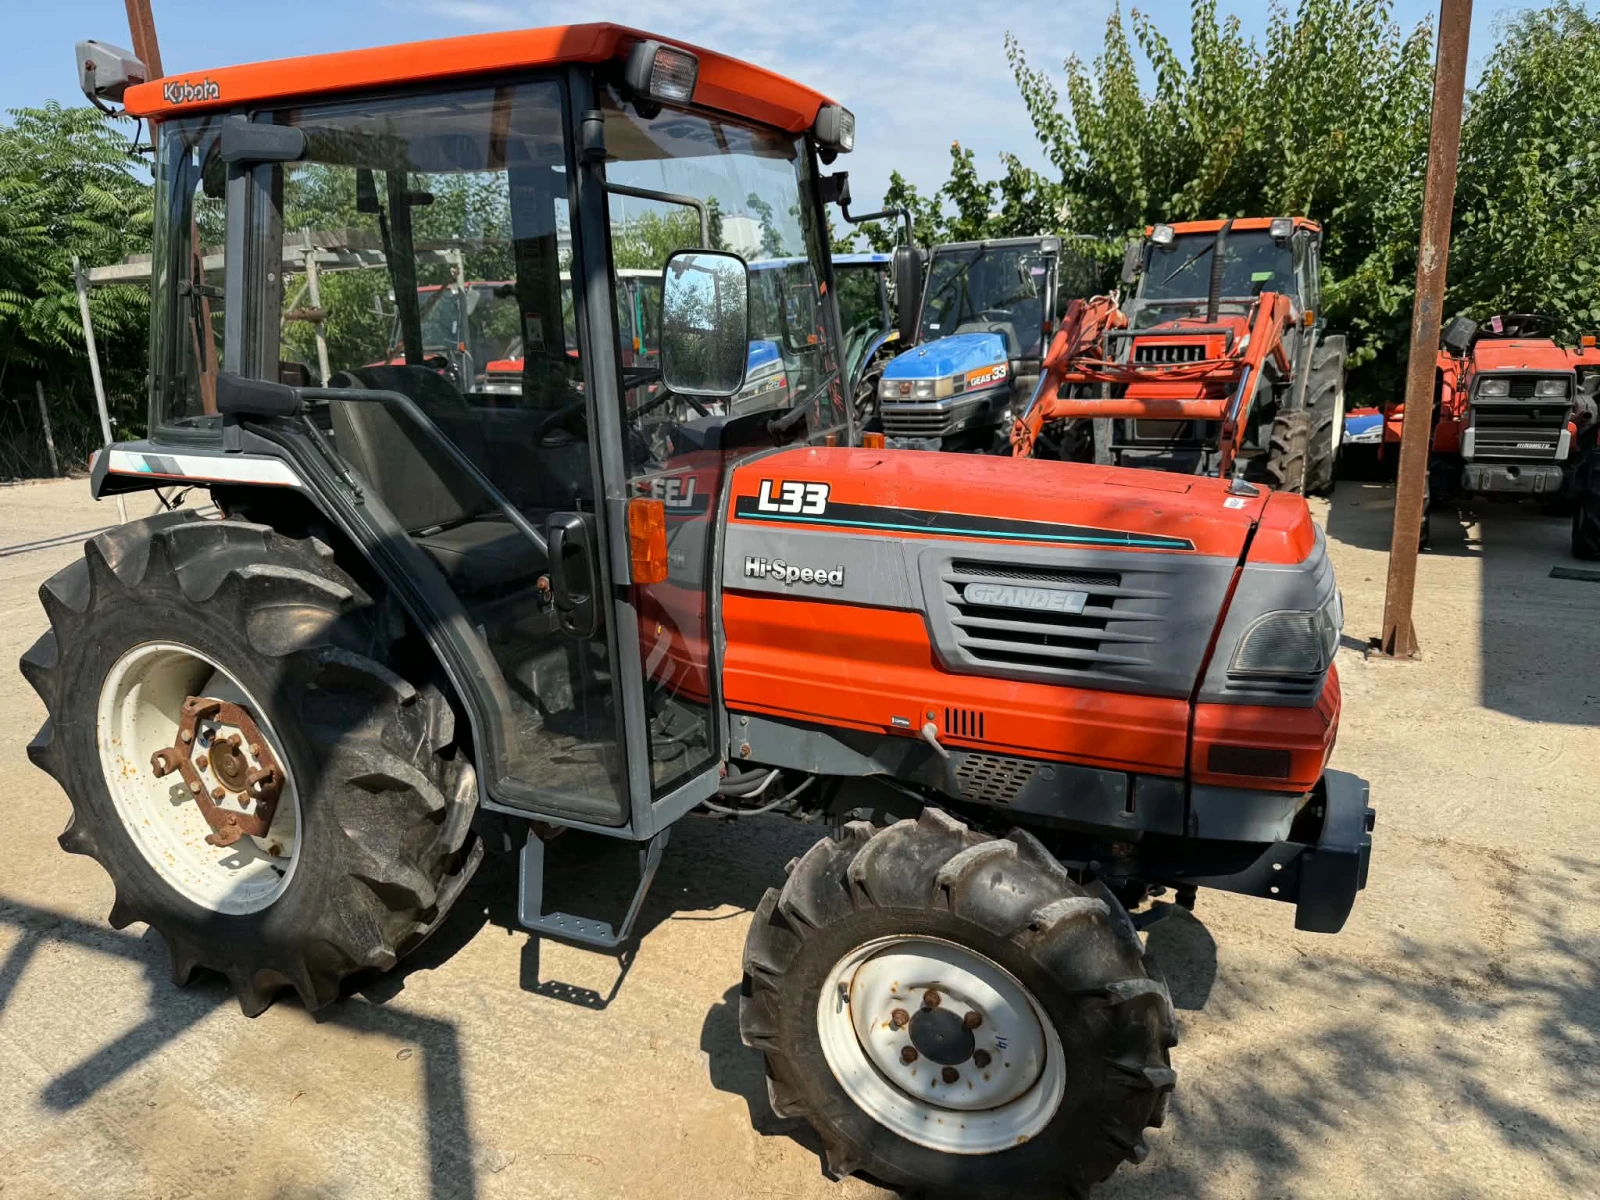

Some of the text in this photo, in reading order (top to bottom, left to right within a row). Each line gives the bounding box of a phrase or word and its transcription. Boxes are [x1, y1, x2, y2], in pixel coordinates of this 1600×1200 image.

[163, 78, 219, 104] Kubota
[992, 364, 1006, 380] 33
[757, 478, 830, 515] L33
[743, 555, 844, 587] Hi-Speed
[973, 586, 1078, 611] GRANDEL
